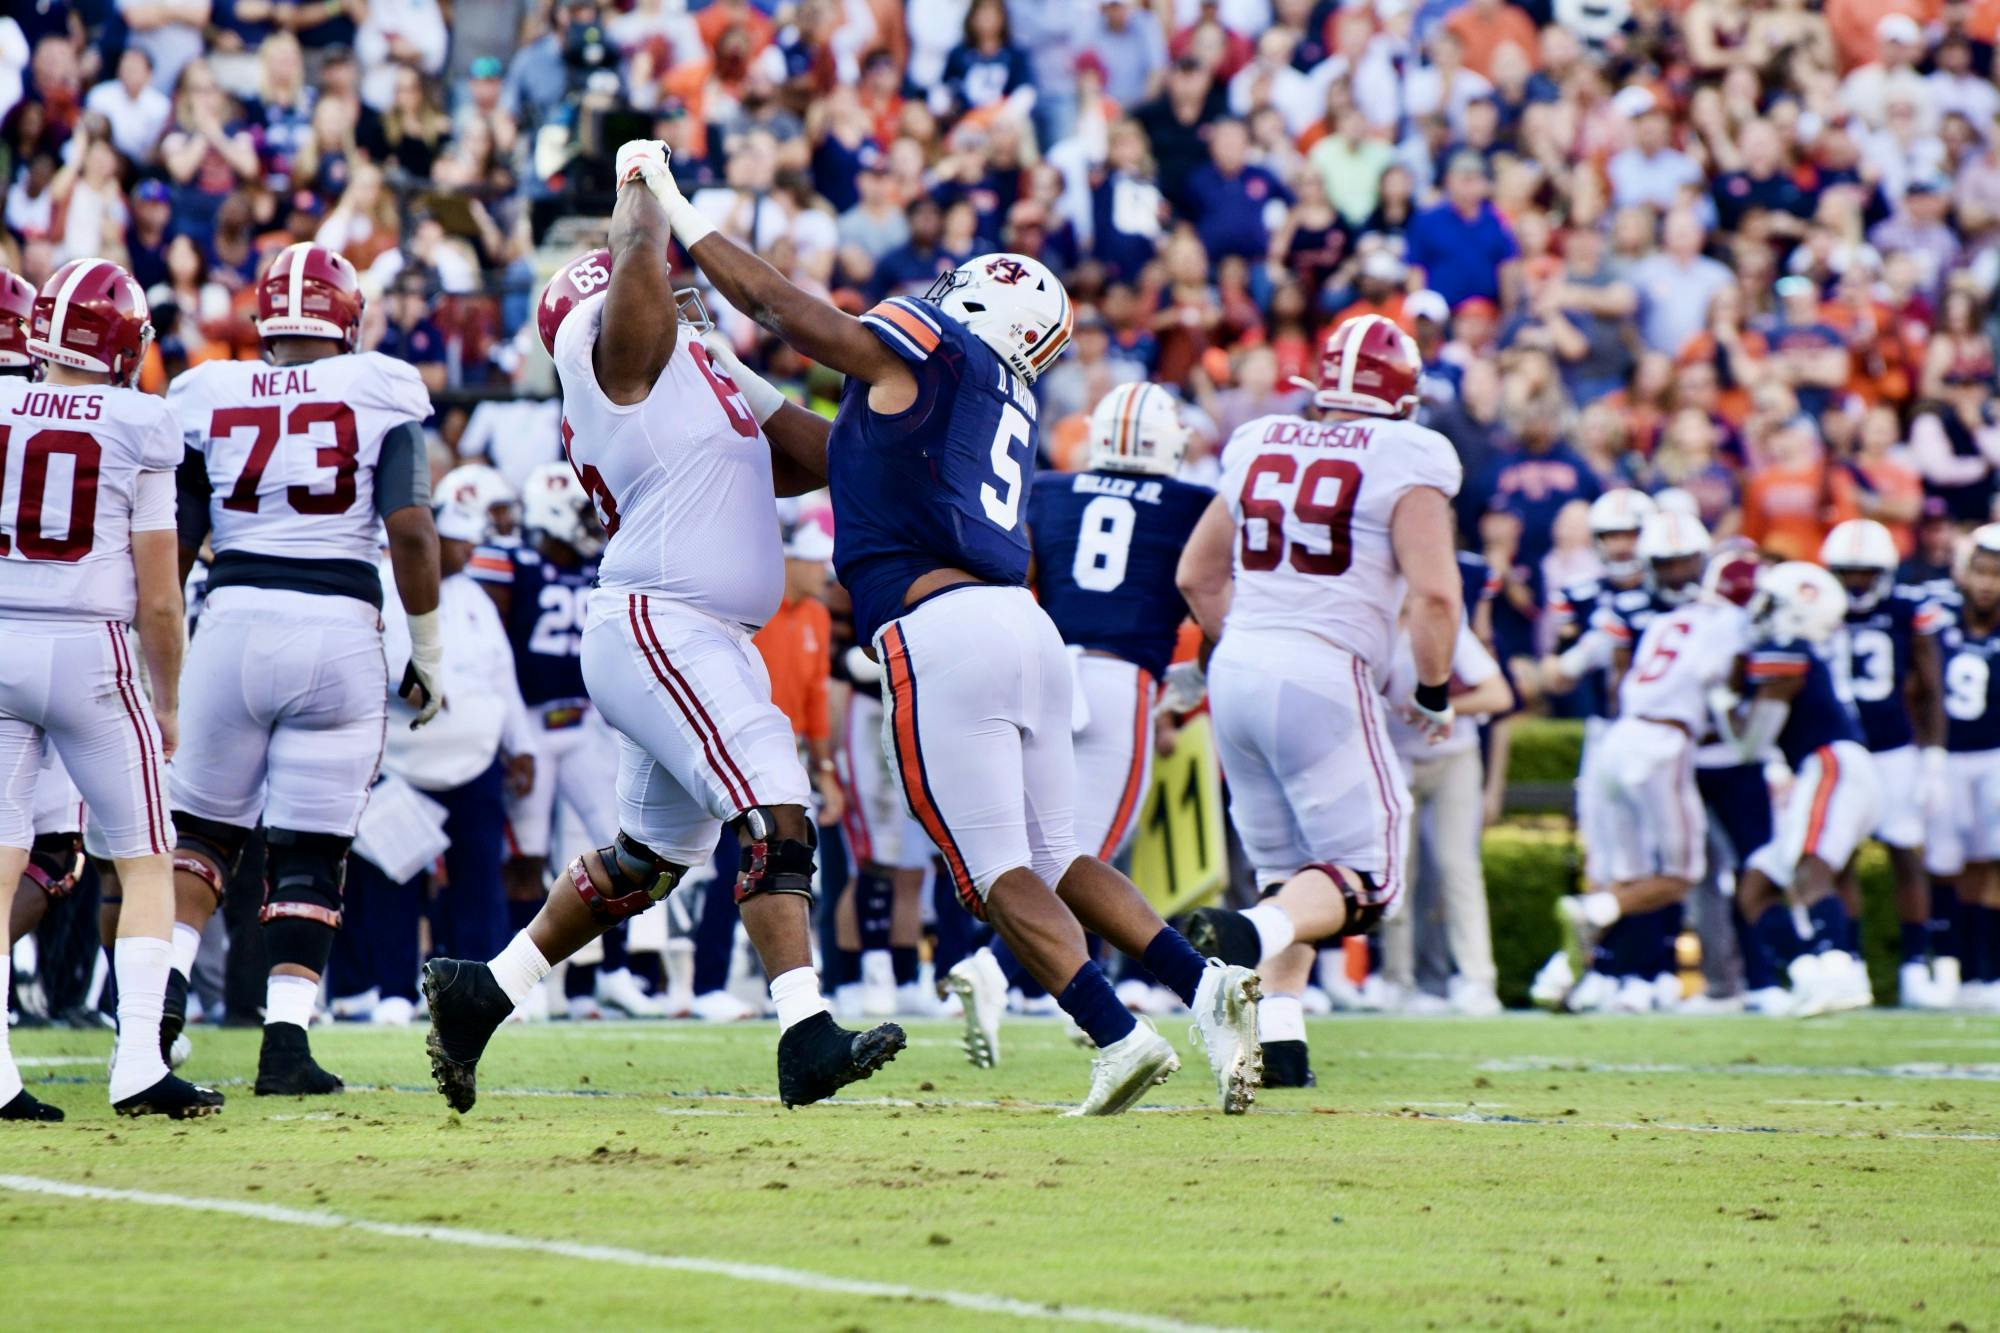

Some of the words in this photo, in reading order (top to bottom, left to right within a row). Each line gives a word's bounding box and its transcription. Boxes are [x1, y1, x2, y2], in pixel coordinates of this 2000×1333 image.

[568, 257, 610, 295] 65
[997, 362, 1009, 395] D.
[1009, 353, 1027, 373] WAR
[252, 369, 317, 398] NEAL
[12, 392, 104, 420] JONES
[1262, 422, 1375, 450] DICKERSON
[210, 401, 360, 516] 73
[980, 401, 1031, 532] 5
[1240, 453, 1363, 577] 69
[1072, 496, 1137, 593] 8
[1148, 757, 1208, 895] 11
